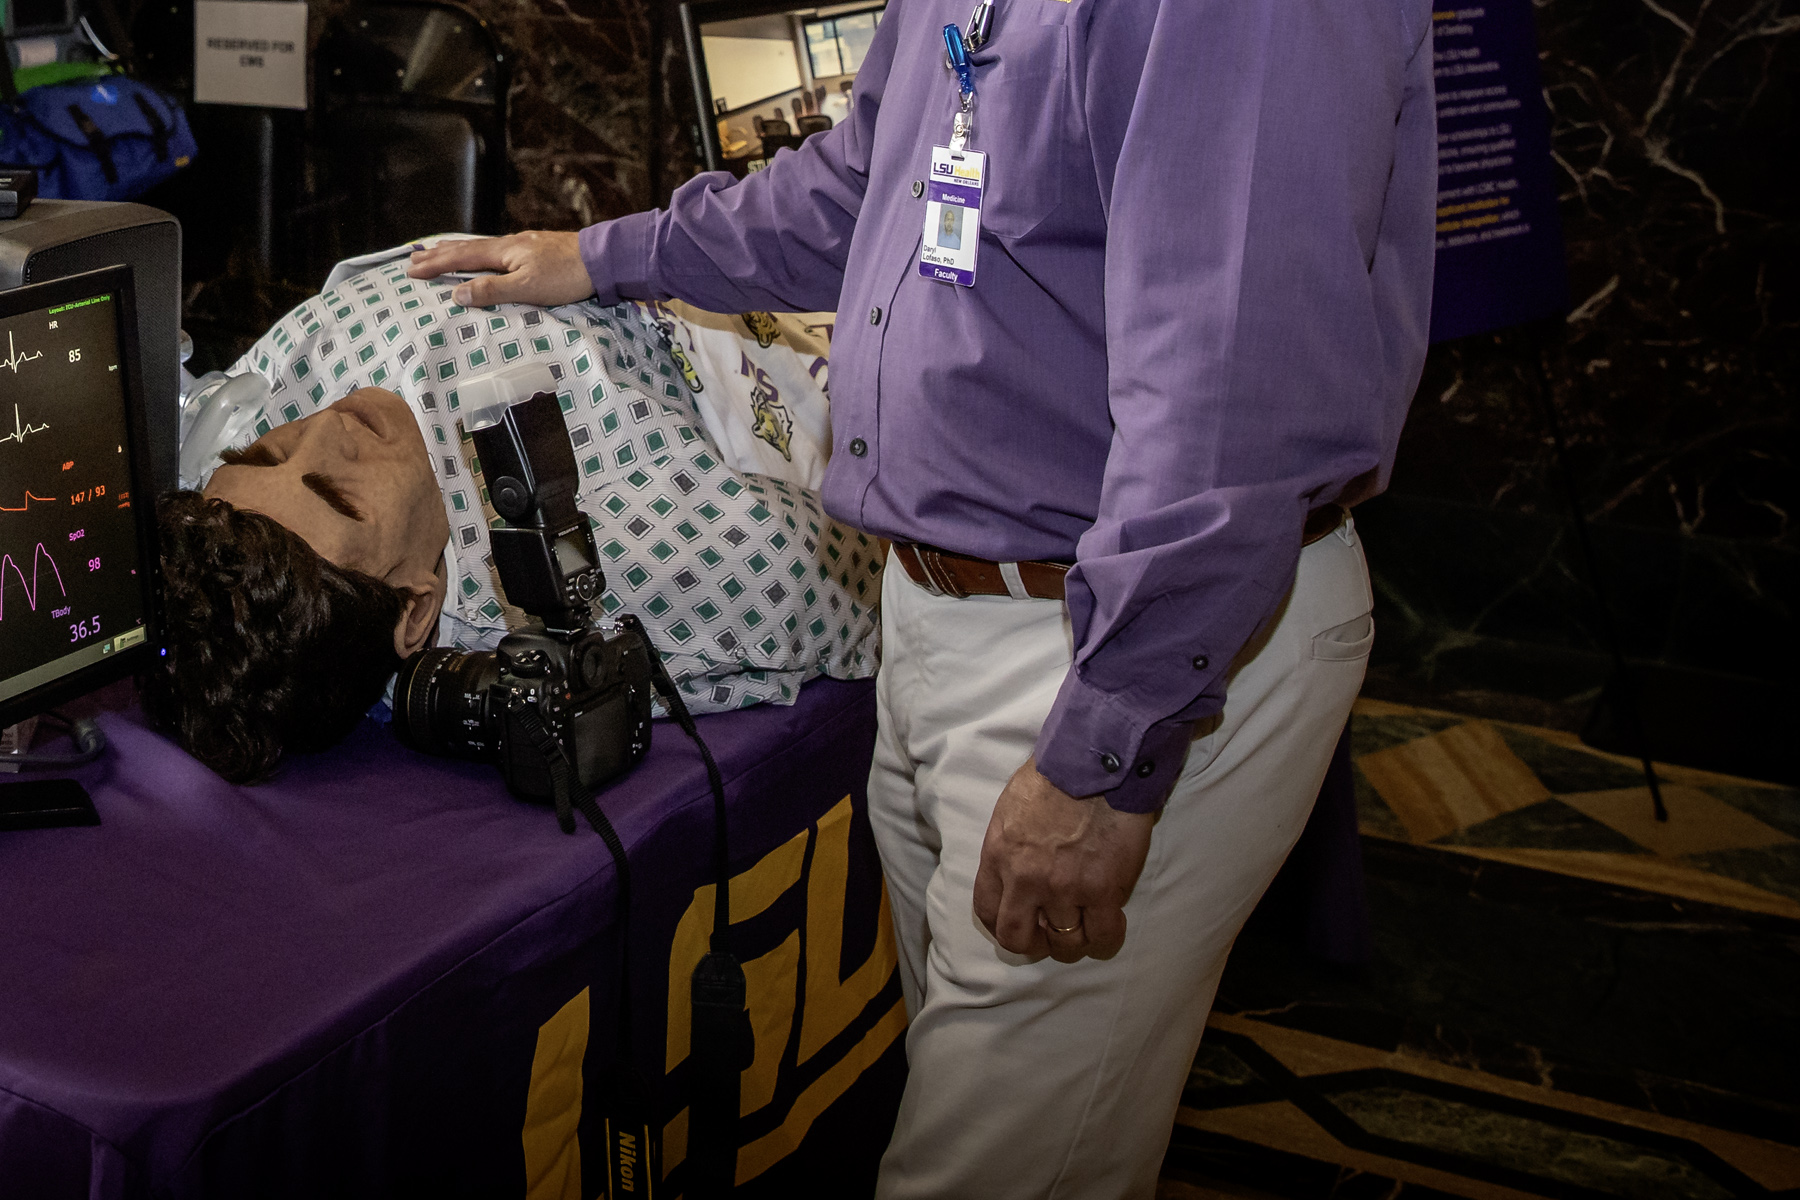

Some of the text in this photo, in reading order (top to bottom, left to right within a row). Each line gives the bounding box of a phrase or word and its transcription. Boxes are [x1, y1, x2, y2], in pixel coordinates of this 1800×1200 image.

[206, 36, 295, 54] RESERVED FOR
[933, 162, 981, 178] LSU Health
[942, 193, 966, 205] Medicine
[923, 244, 937, 255] Daryl
[943, 256, 955, 266] PhD
[934, 268, 959, 283] Faculty
[48, 320, 58, 330] HR
[68, 348, 81, 363] 85
[70, 491, 85, 506] 147
[95, 484, 106, 497] 93
[68, 528, 85, 542] SpO2
[88, 557, 101, 572] 98
[51, 606, 72, 619] TBody
[69, 615, 101, 643] 36.5
[618, 1130, 637, 1193] Nikon
